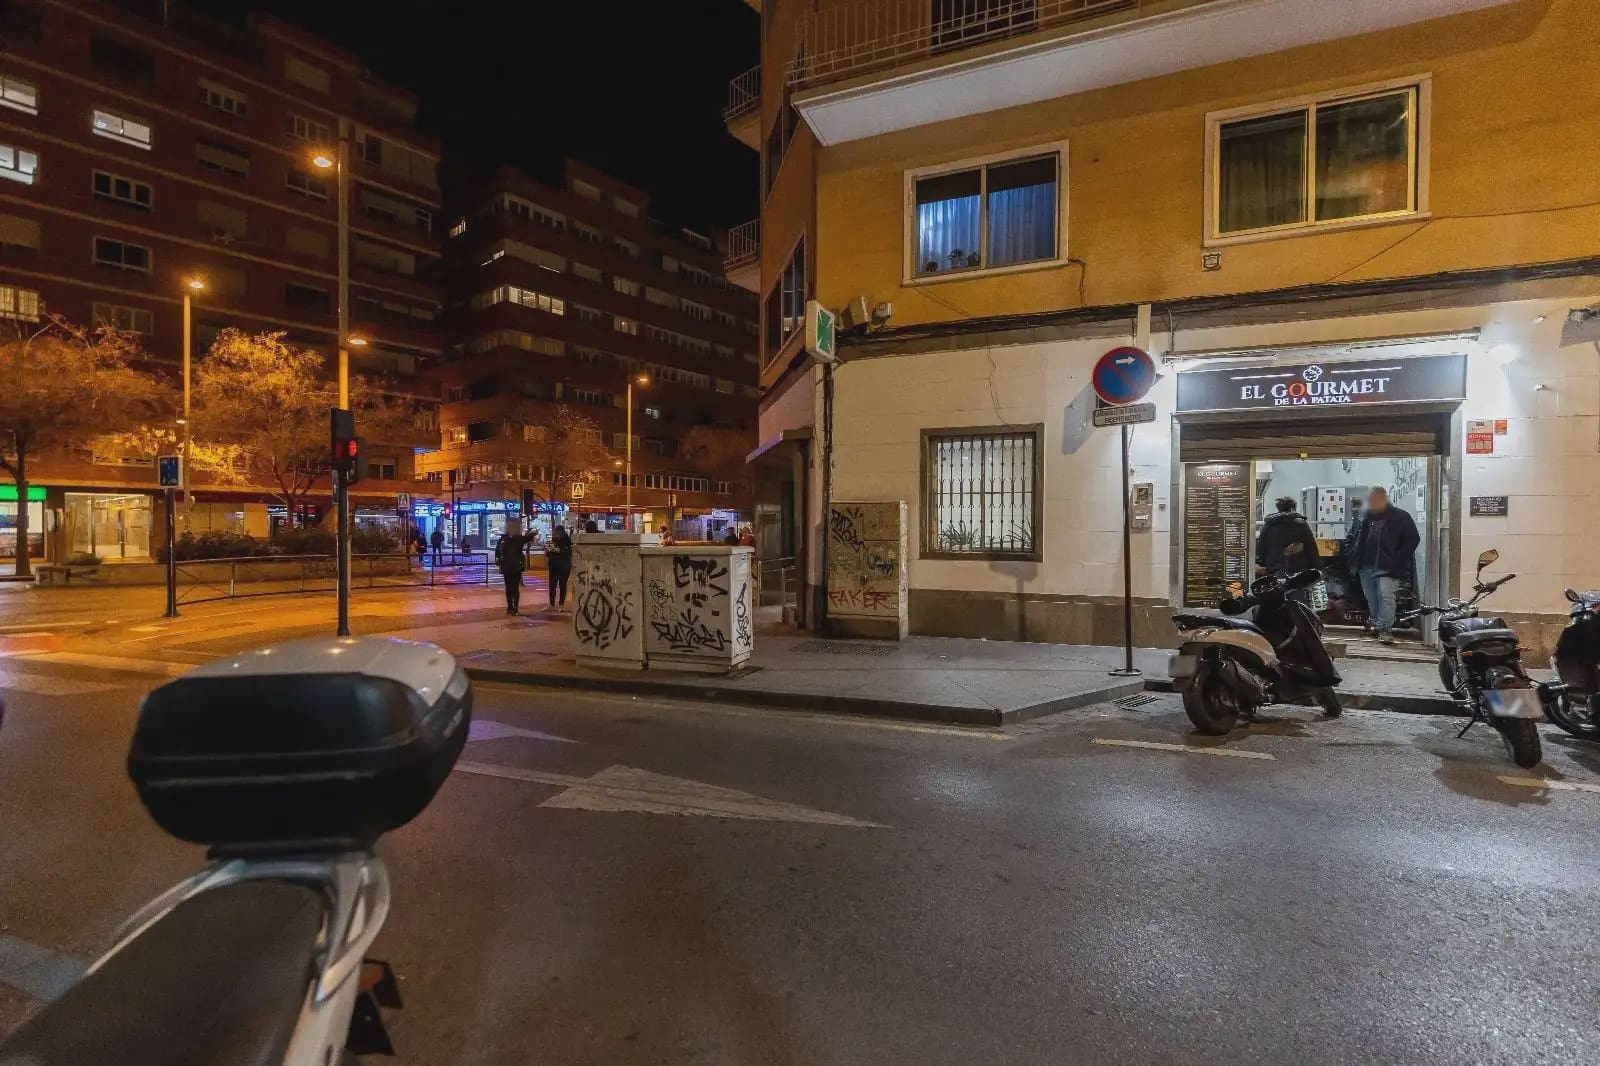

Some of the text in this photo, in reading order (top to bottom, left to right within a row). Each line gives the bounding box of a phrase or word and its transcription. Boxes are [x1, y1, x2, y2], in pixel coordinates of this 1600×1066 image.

[1240, 377, 1390, 400] EL GOURMET
[1274, 395, 1351, 406] DE LA PATATA
